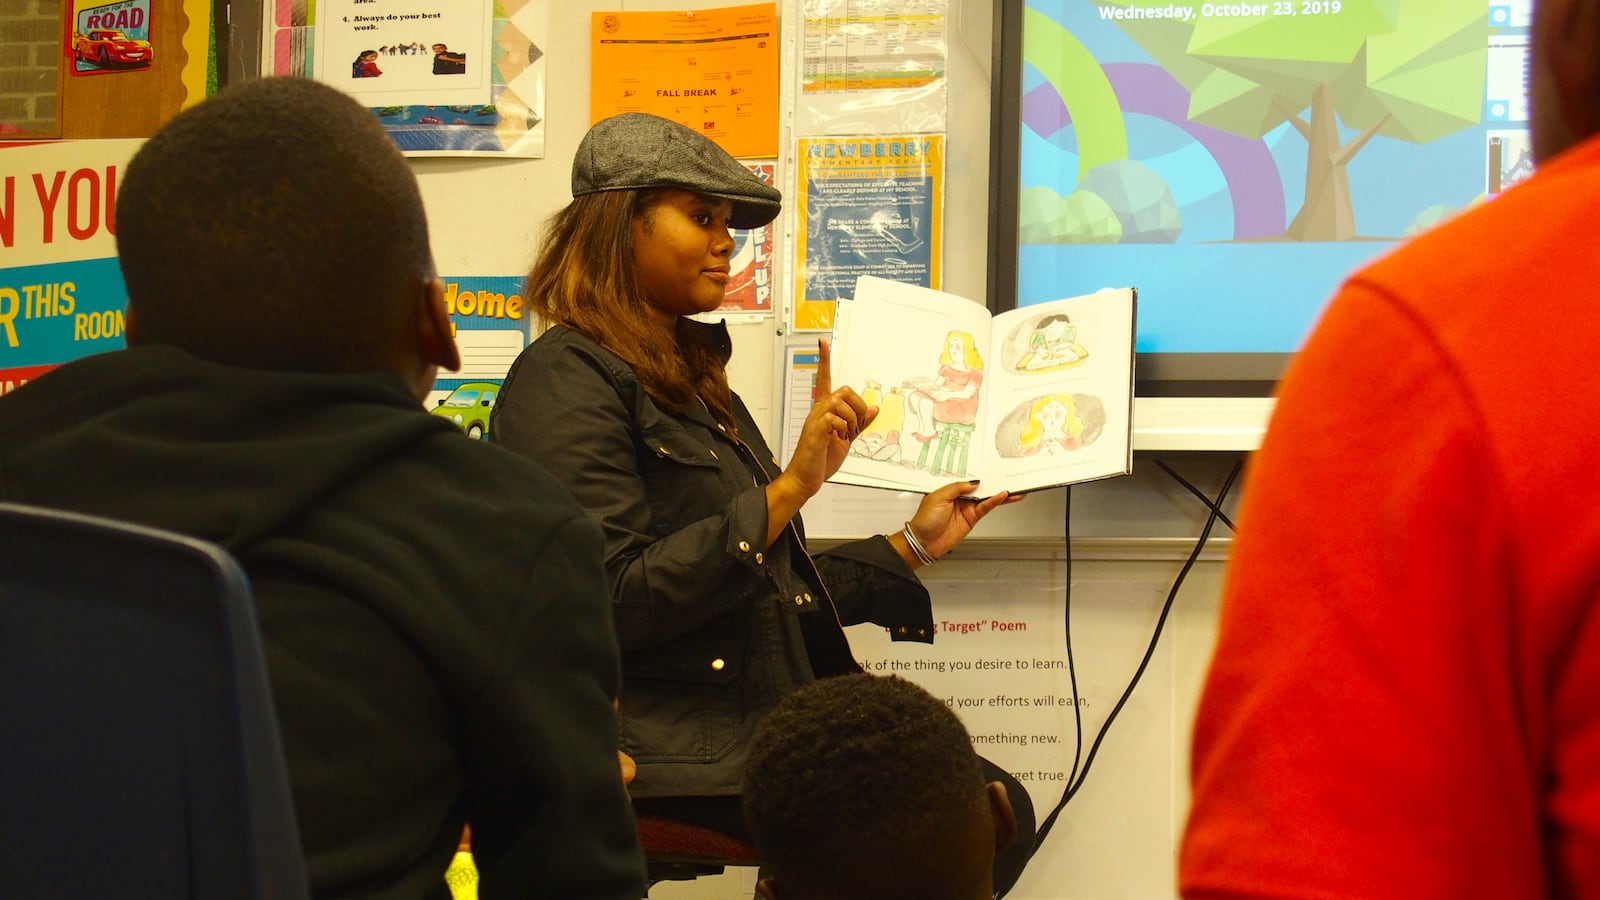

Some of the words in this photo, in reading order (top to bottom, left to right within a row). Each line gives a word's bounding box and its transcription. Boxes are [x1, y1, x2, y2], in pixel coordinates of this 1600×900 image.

[353, 15, 385, 23] Always
[399, 13, 420, 21] your
[1099, 5, 1196, 20] Wednesday,
[1201, 2, 1268, 17] October
[1272, 2, 1296, 17] 23,
[1302, 1, 1341, 15] 2019
[86, 8, 144, 29] ROAD
[656, 89, 681, 97] FALL
[683, 88, 717, 97] BREAK
[808, 142, 932, 158] NEWBERRY
[21, 281, 76, 320] THIS
[991, 620, 1027, 632] Poem
[875, 658, 888, 671] of
[891, 659, 911, 671] the
[914, 658, 945, 672] thing
[948, 660, 971, 673] you
[975, 658, 1012, 671] desire
[1016, 660, 1029, 670] to
[1032, 658, 1067, 670] learn.
[957, 697, 985, 710] your
[988, 695, 1030, 707] efforts
[1033, 695, 1055, 707] will
[1058, 697, 1090, 709] ean,
[969, 733, 1027, 746] omething
[1031, 734, 1061, 744] new.
[1038, 770, 1068, 781] true.
